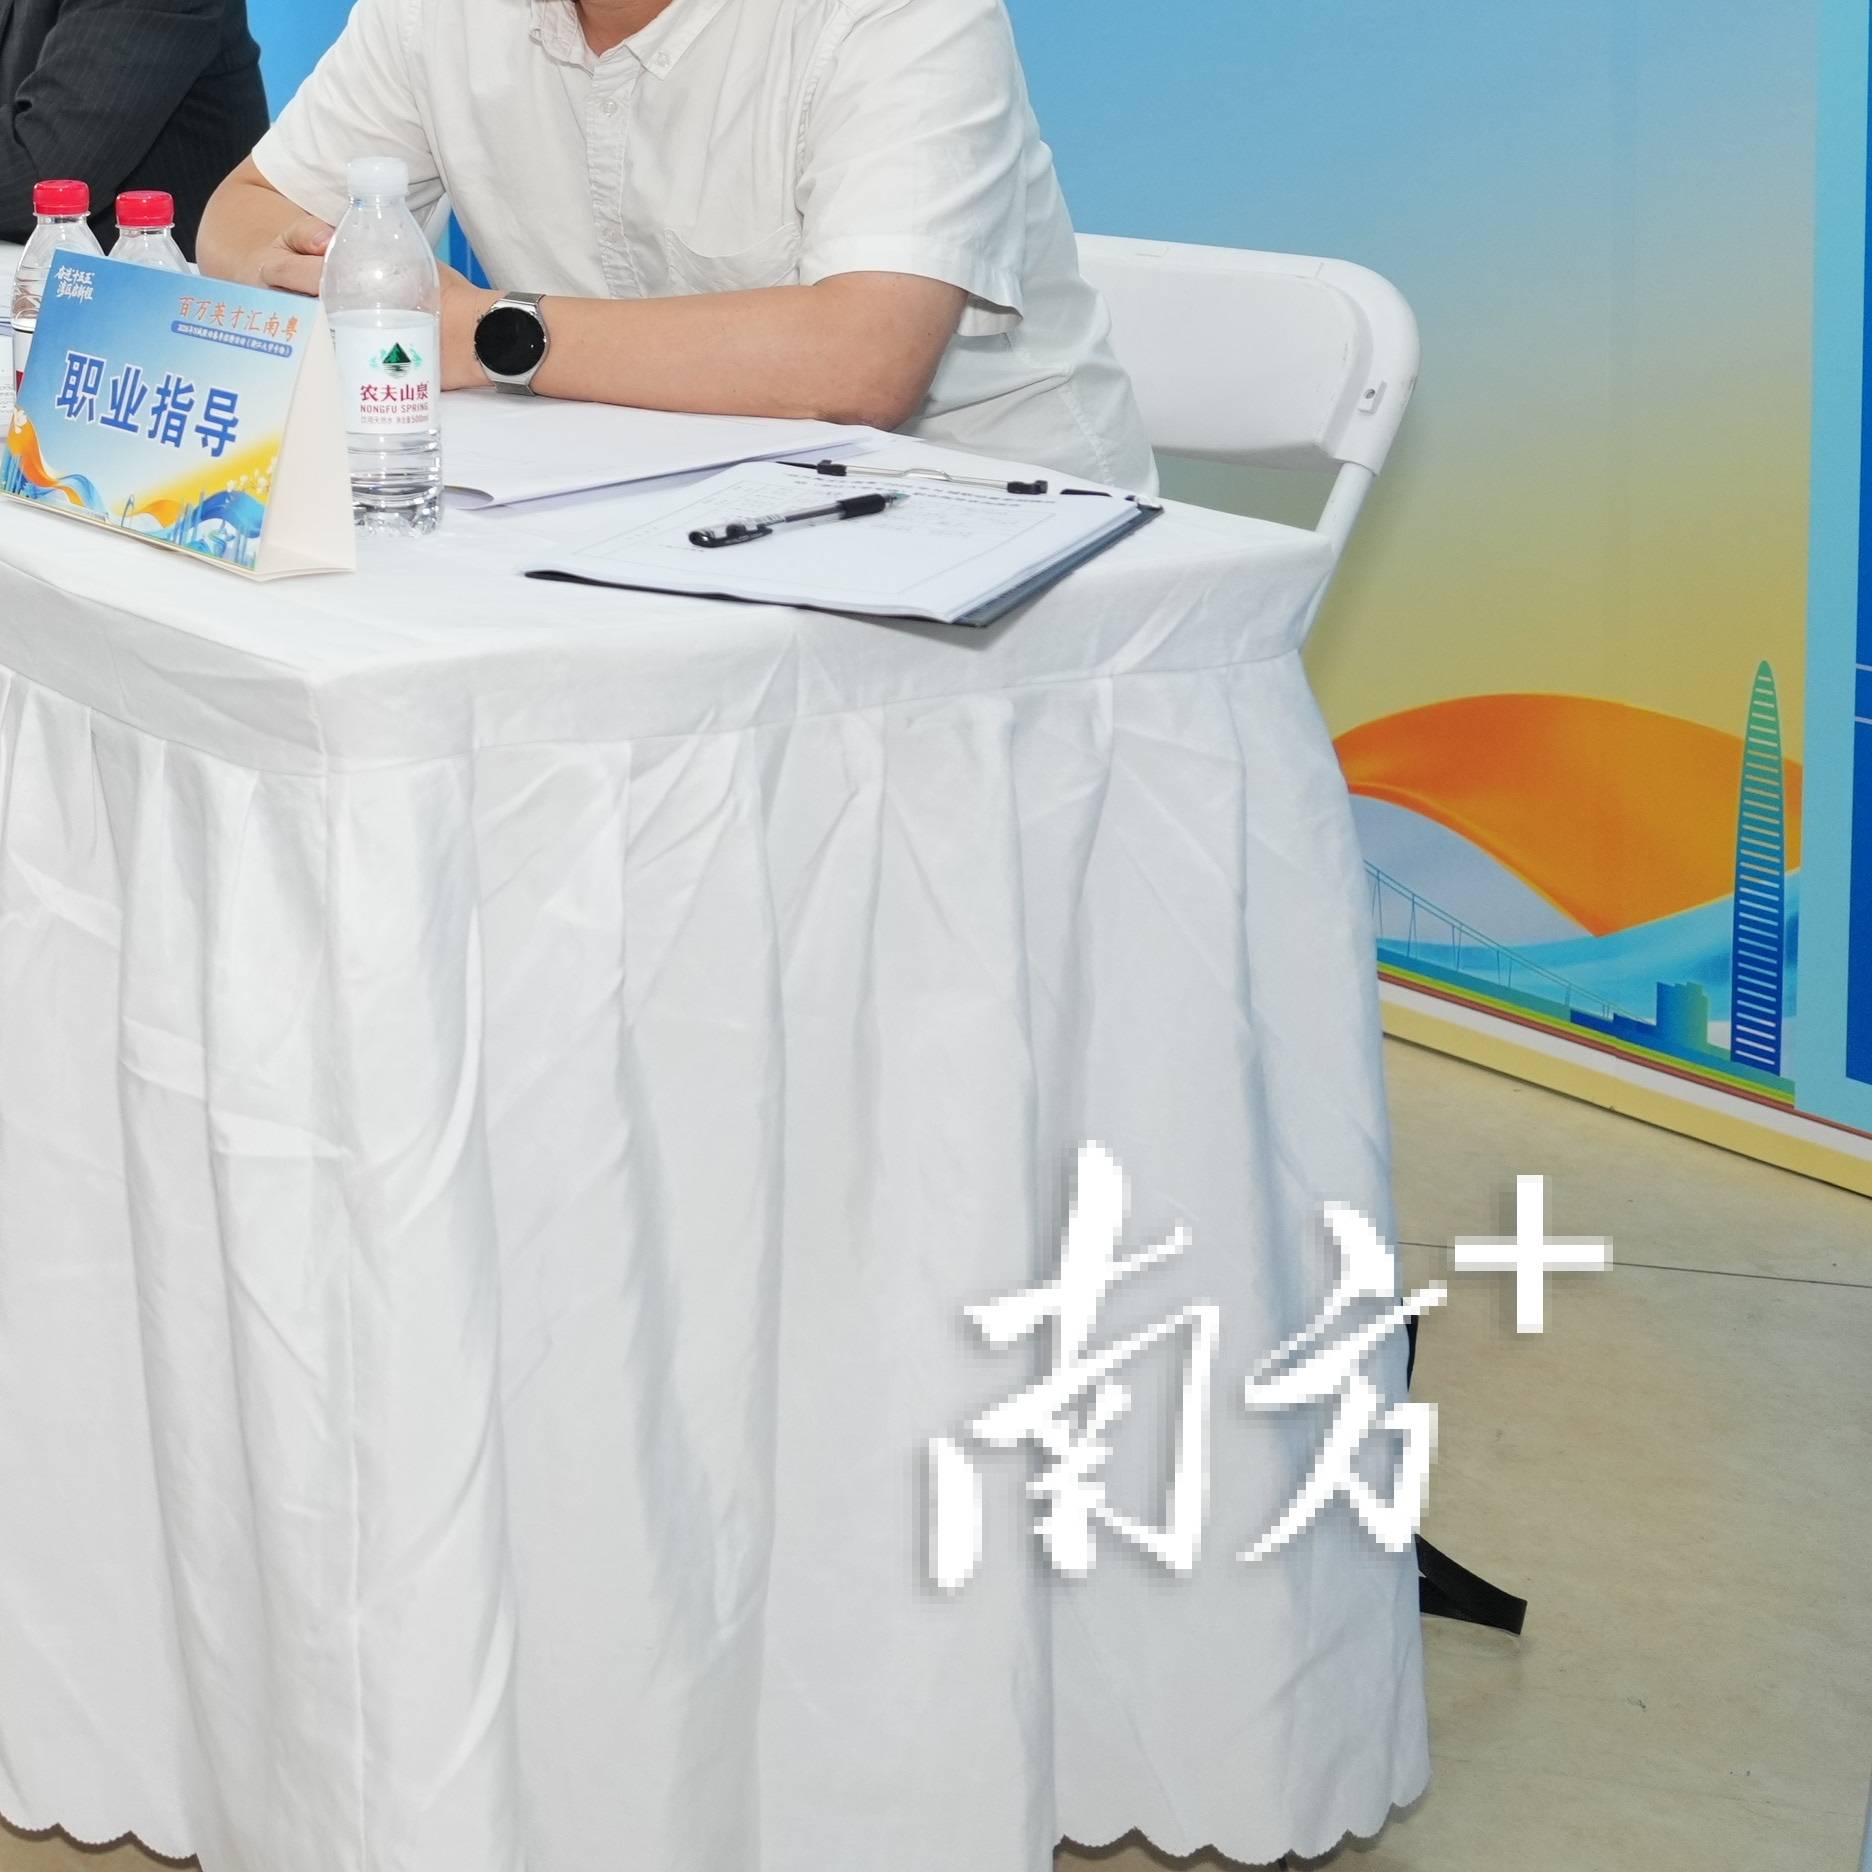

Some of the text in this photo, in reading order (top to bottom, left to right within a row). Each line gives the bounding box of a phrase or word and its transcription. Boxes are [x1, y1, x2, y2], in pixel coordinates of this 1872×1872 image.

[177, 295, 301, 343] 百万英才汇南粤
[55, 350, 240, 458] 职业指导
[360, 383, 429, 402] 农夫山泉
[360, 402, 429, 414] NONGFU SPRING
